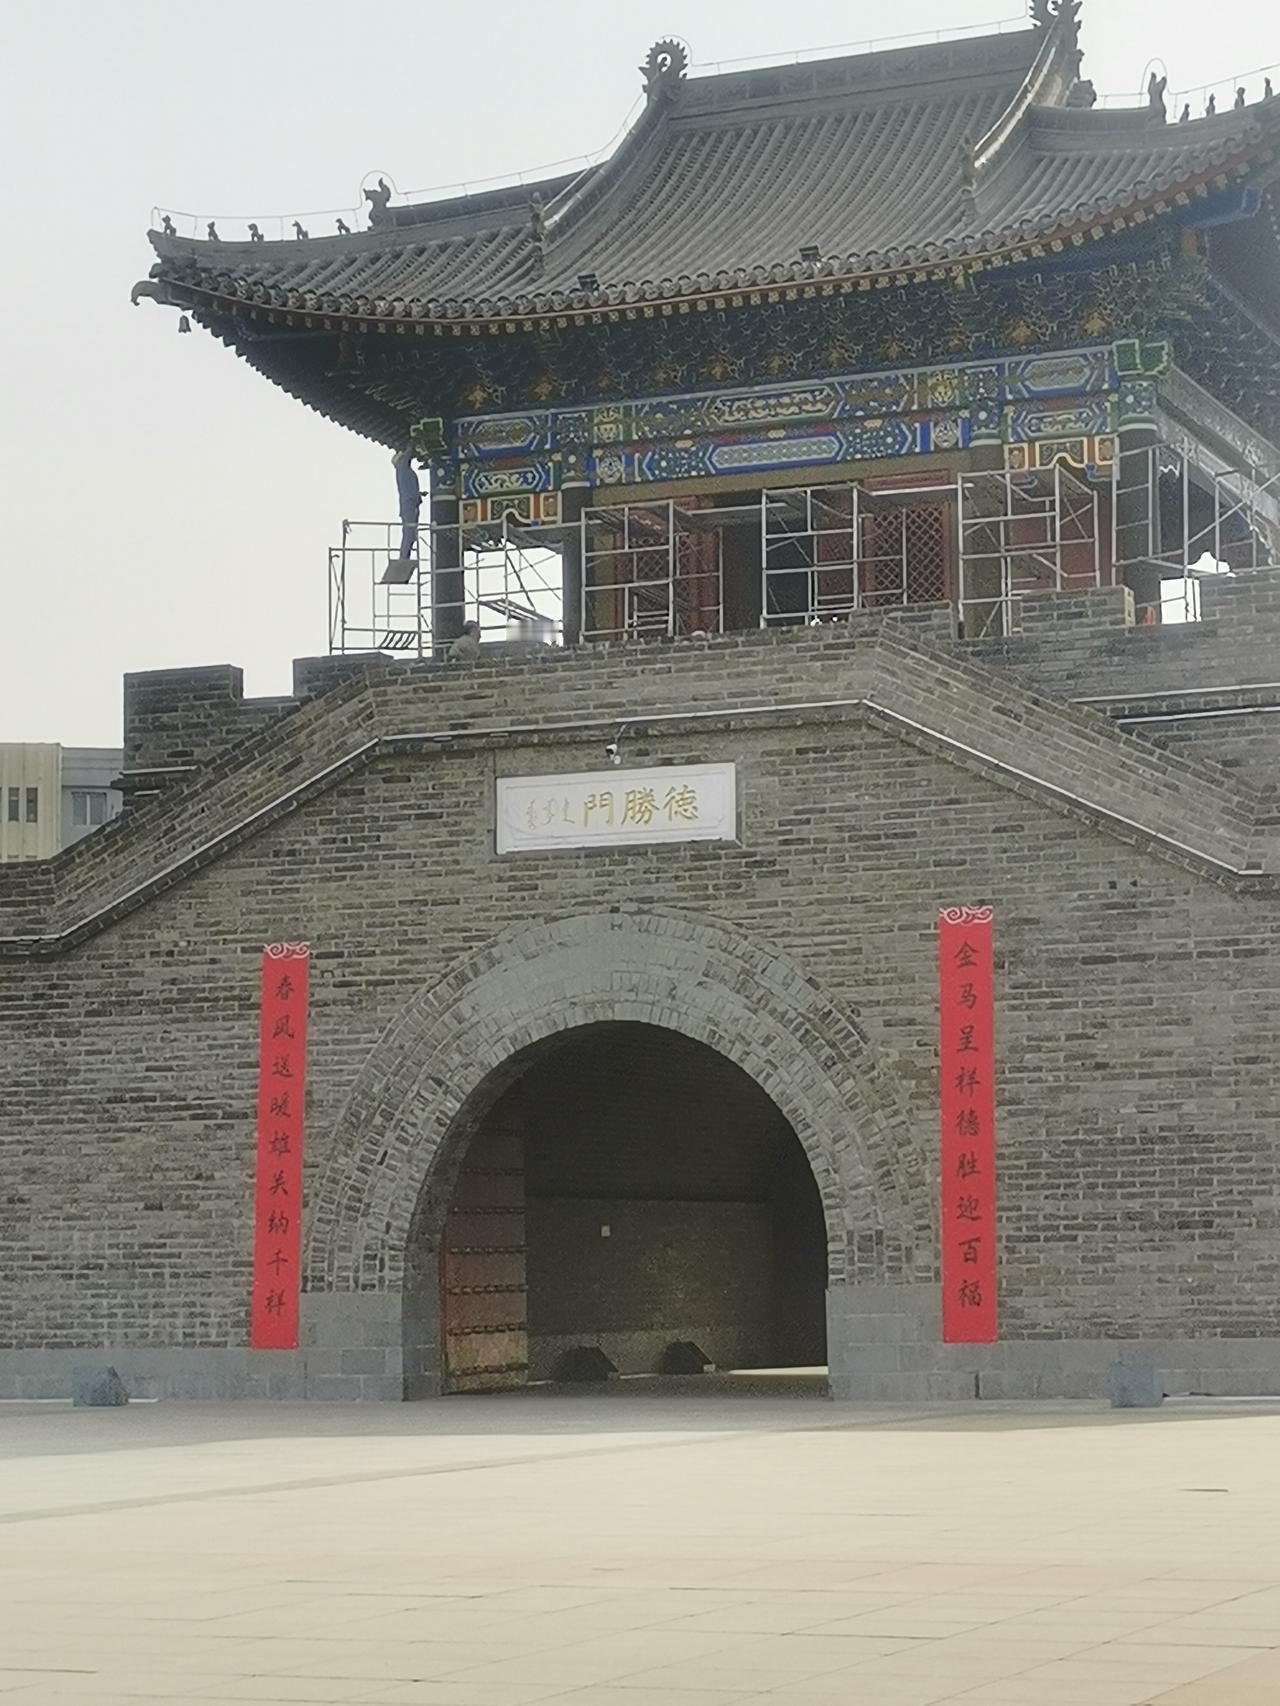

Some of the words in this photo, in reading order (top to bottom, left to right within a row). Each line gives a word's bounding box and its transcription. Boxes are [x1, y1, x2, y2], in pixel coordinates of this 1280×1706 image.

[263, 975, 295, 1315] 春风送暖雄关纳千祥
[953, 941, 984, 1308] 金马呈祥德胜迎百福
